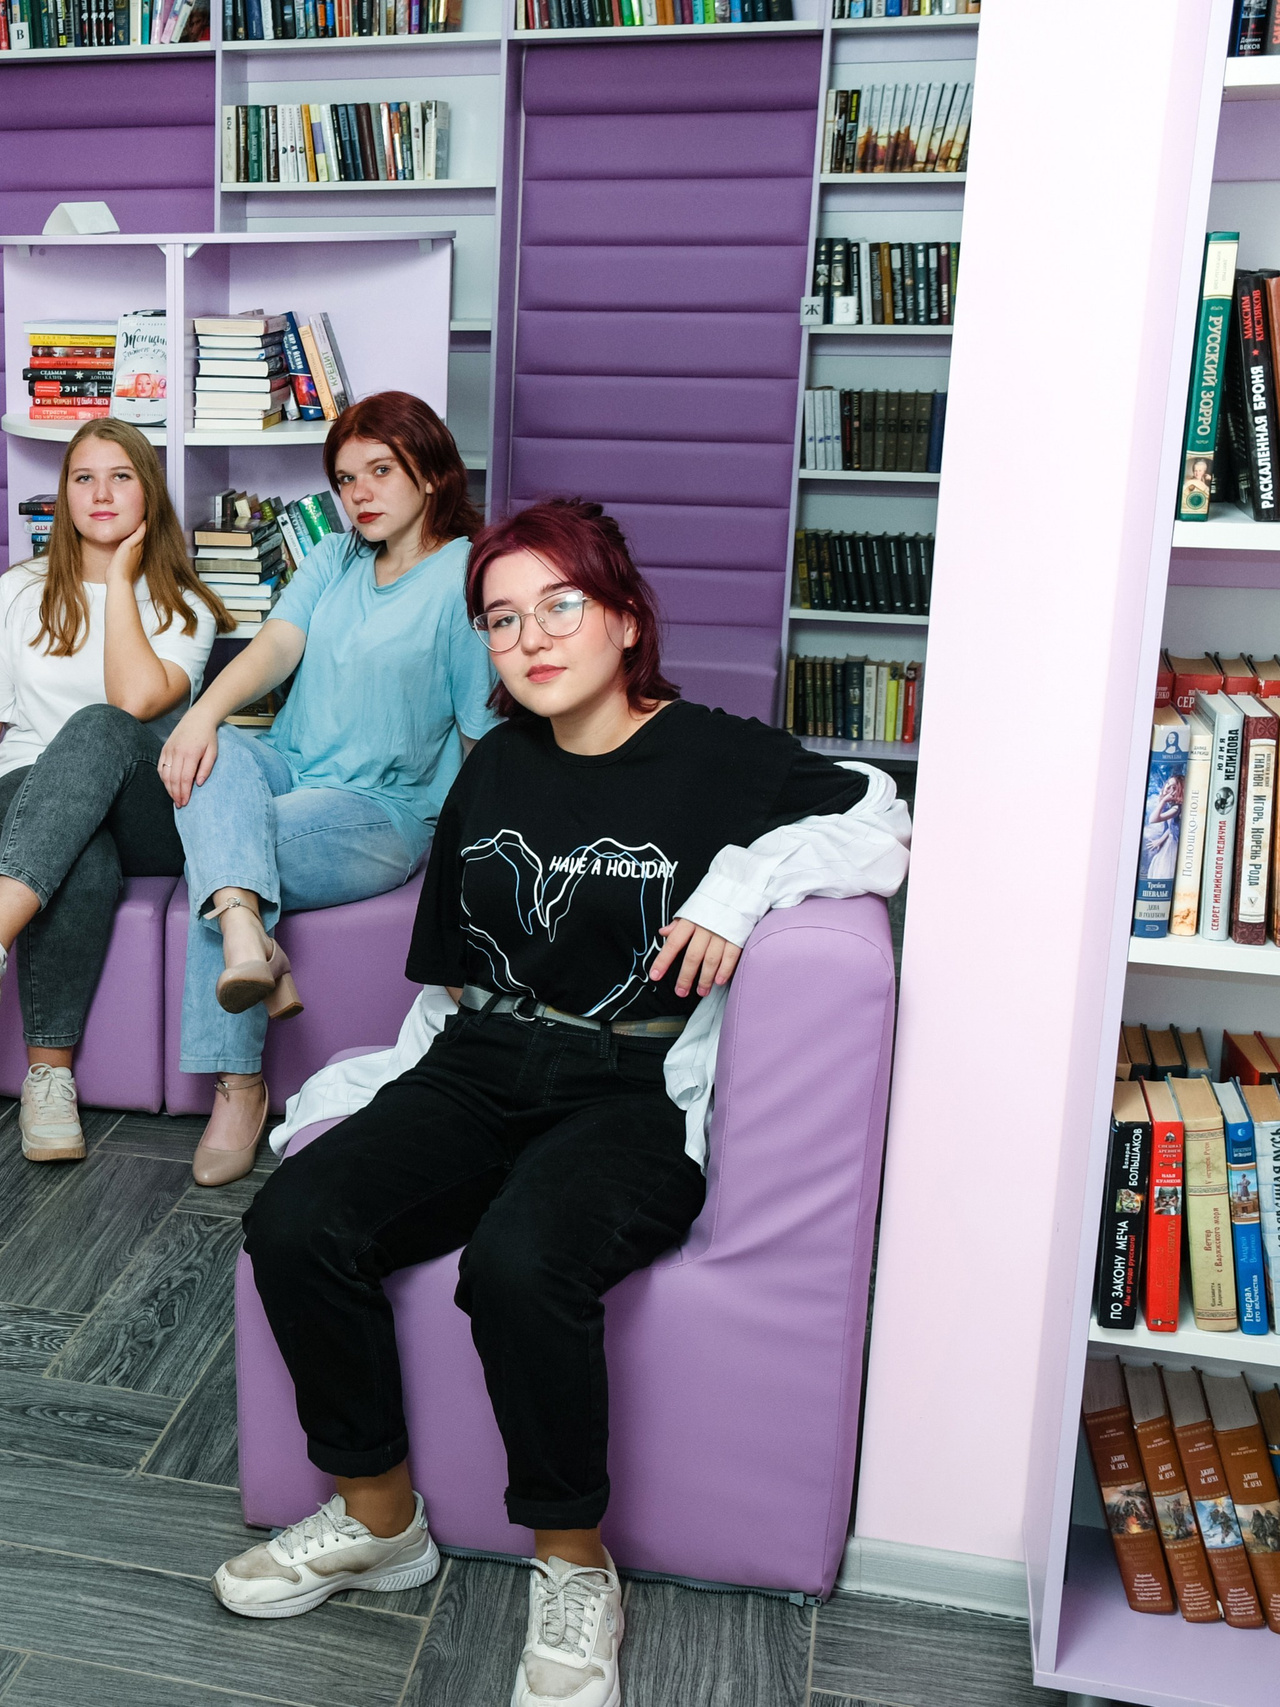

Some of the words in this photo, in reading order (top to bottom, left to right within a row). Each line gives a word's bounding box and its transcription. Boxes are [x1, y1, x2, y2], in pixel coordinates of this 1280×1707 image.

[16, 29, 24, 40] В
[804, 304, 820, 316] Ж
[1241, 295, 1253, 340] МАКСИМ
[1252, 289, 1264, 342] КИСЛЯКОВ
[1202, 315, 1223, 387] РУССКИЙ
[322, 351, 338, 387] КРЕДИТ
[1250, 365, 1267, 411] БРОНЯ
[1197, 390, 1215, 436] ЗОРРО
[1254, 415, 1274, 509] РАСКАЛЕННАЯ
[1177, 696, 1195, 708] СЕР
[1217, 738, 1226, 771] ЮЛИЯ
[1224, 728, 1239, 781] НЕЛИДОВА
[1216, 820, 1227, 855] МЕДИУМА
[549, 855, 588, 874] HAVE
[591, 858, 601, 875] A
[606, 858, 679, 879] HOLIDAY
[1213, 856, 1224, 904] ИНДИЙСКОГО
[1211, 905, 1220, 931] СЕКРЕТ
[1122, 1142, 1131, 1169] Валерий
[1129, 1128, 1143, 1187] БОЛЬШАКОВ
[1119, 1220, 1130, 1251] МЕЧА
[1111, 1254, 1126, 1298] ЗАКОНУ
[1126, 1285, 1132, 1294] от
[1110, 1302, 1122, 1320] ПО
[1124, 1296, 1131, 1307] Мы
